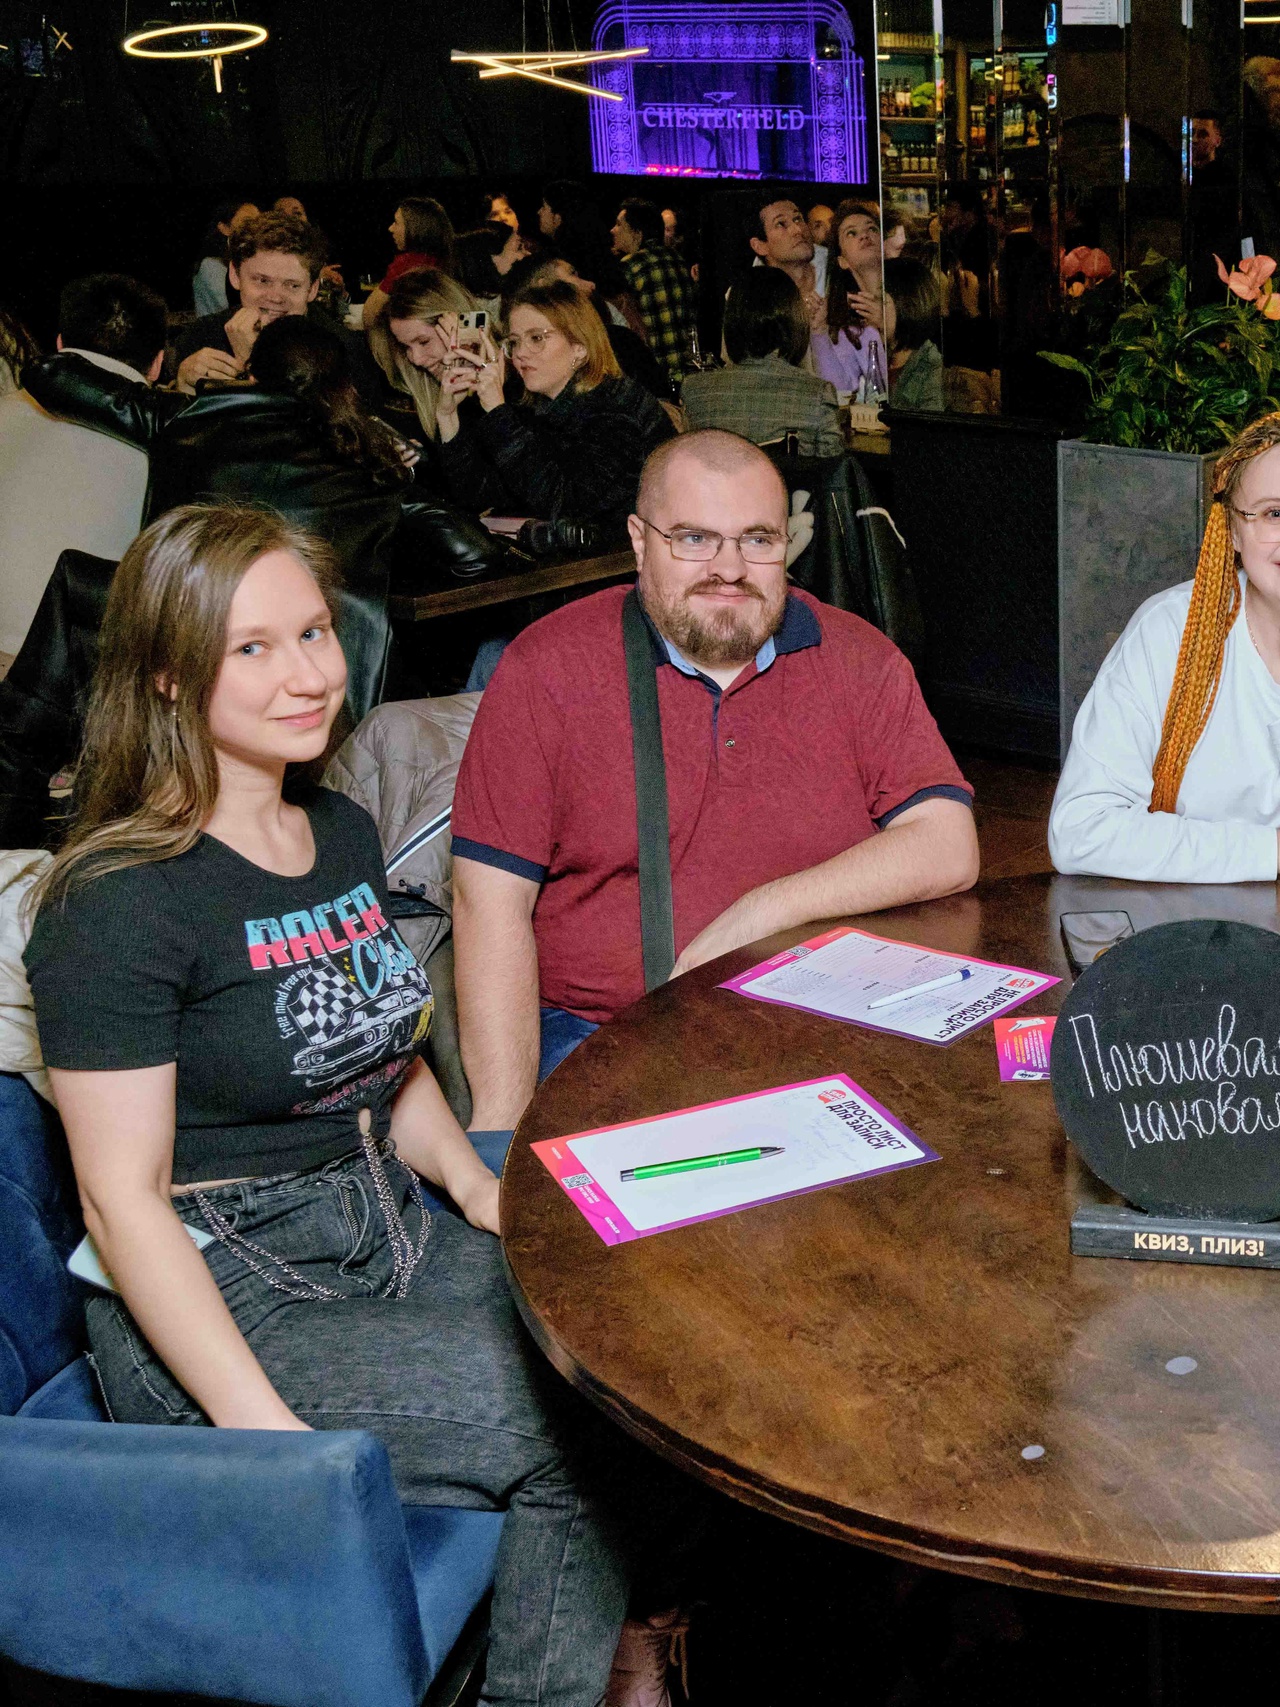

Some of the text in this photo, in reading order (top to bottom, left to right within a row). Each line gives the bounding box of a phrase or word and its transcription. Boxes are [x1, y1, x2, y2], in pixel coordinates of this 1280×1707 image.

[642, 106, 805, 130] CHESTERFIELD
[244, 882, 389, 971] RACER
[279, 974, 300, 993] free
[984, 986, 1009, 1000] ДЛЯ
[1003, 989, 1021, 998] НЕ
[274, 988, 289, 1014] mind
[963, 997, 1007, 1022] ПРОСТО
[934, 1021, 966, 1038] ЛИСТ
[826, 1104, 888, 1150] ДЛЯ ЗАПИСИ
[841, 1100, 882, 1130] ПРОСТО
[877, 1129, 907, 1150] ЛИСТ
[1133, 1233, 1265, 1257] КВИЗ, ПЛИЗ!
